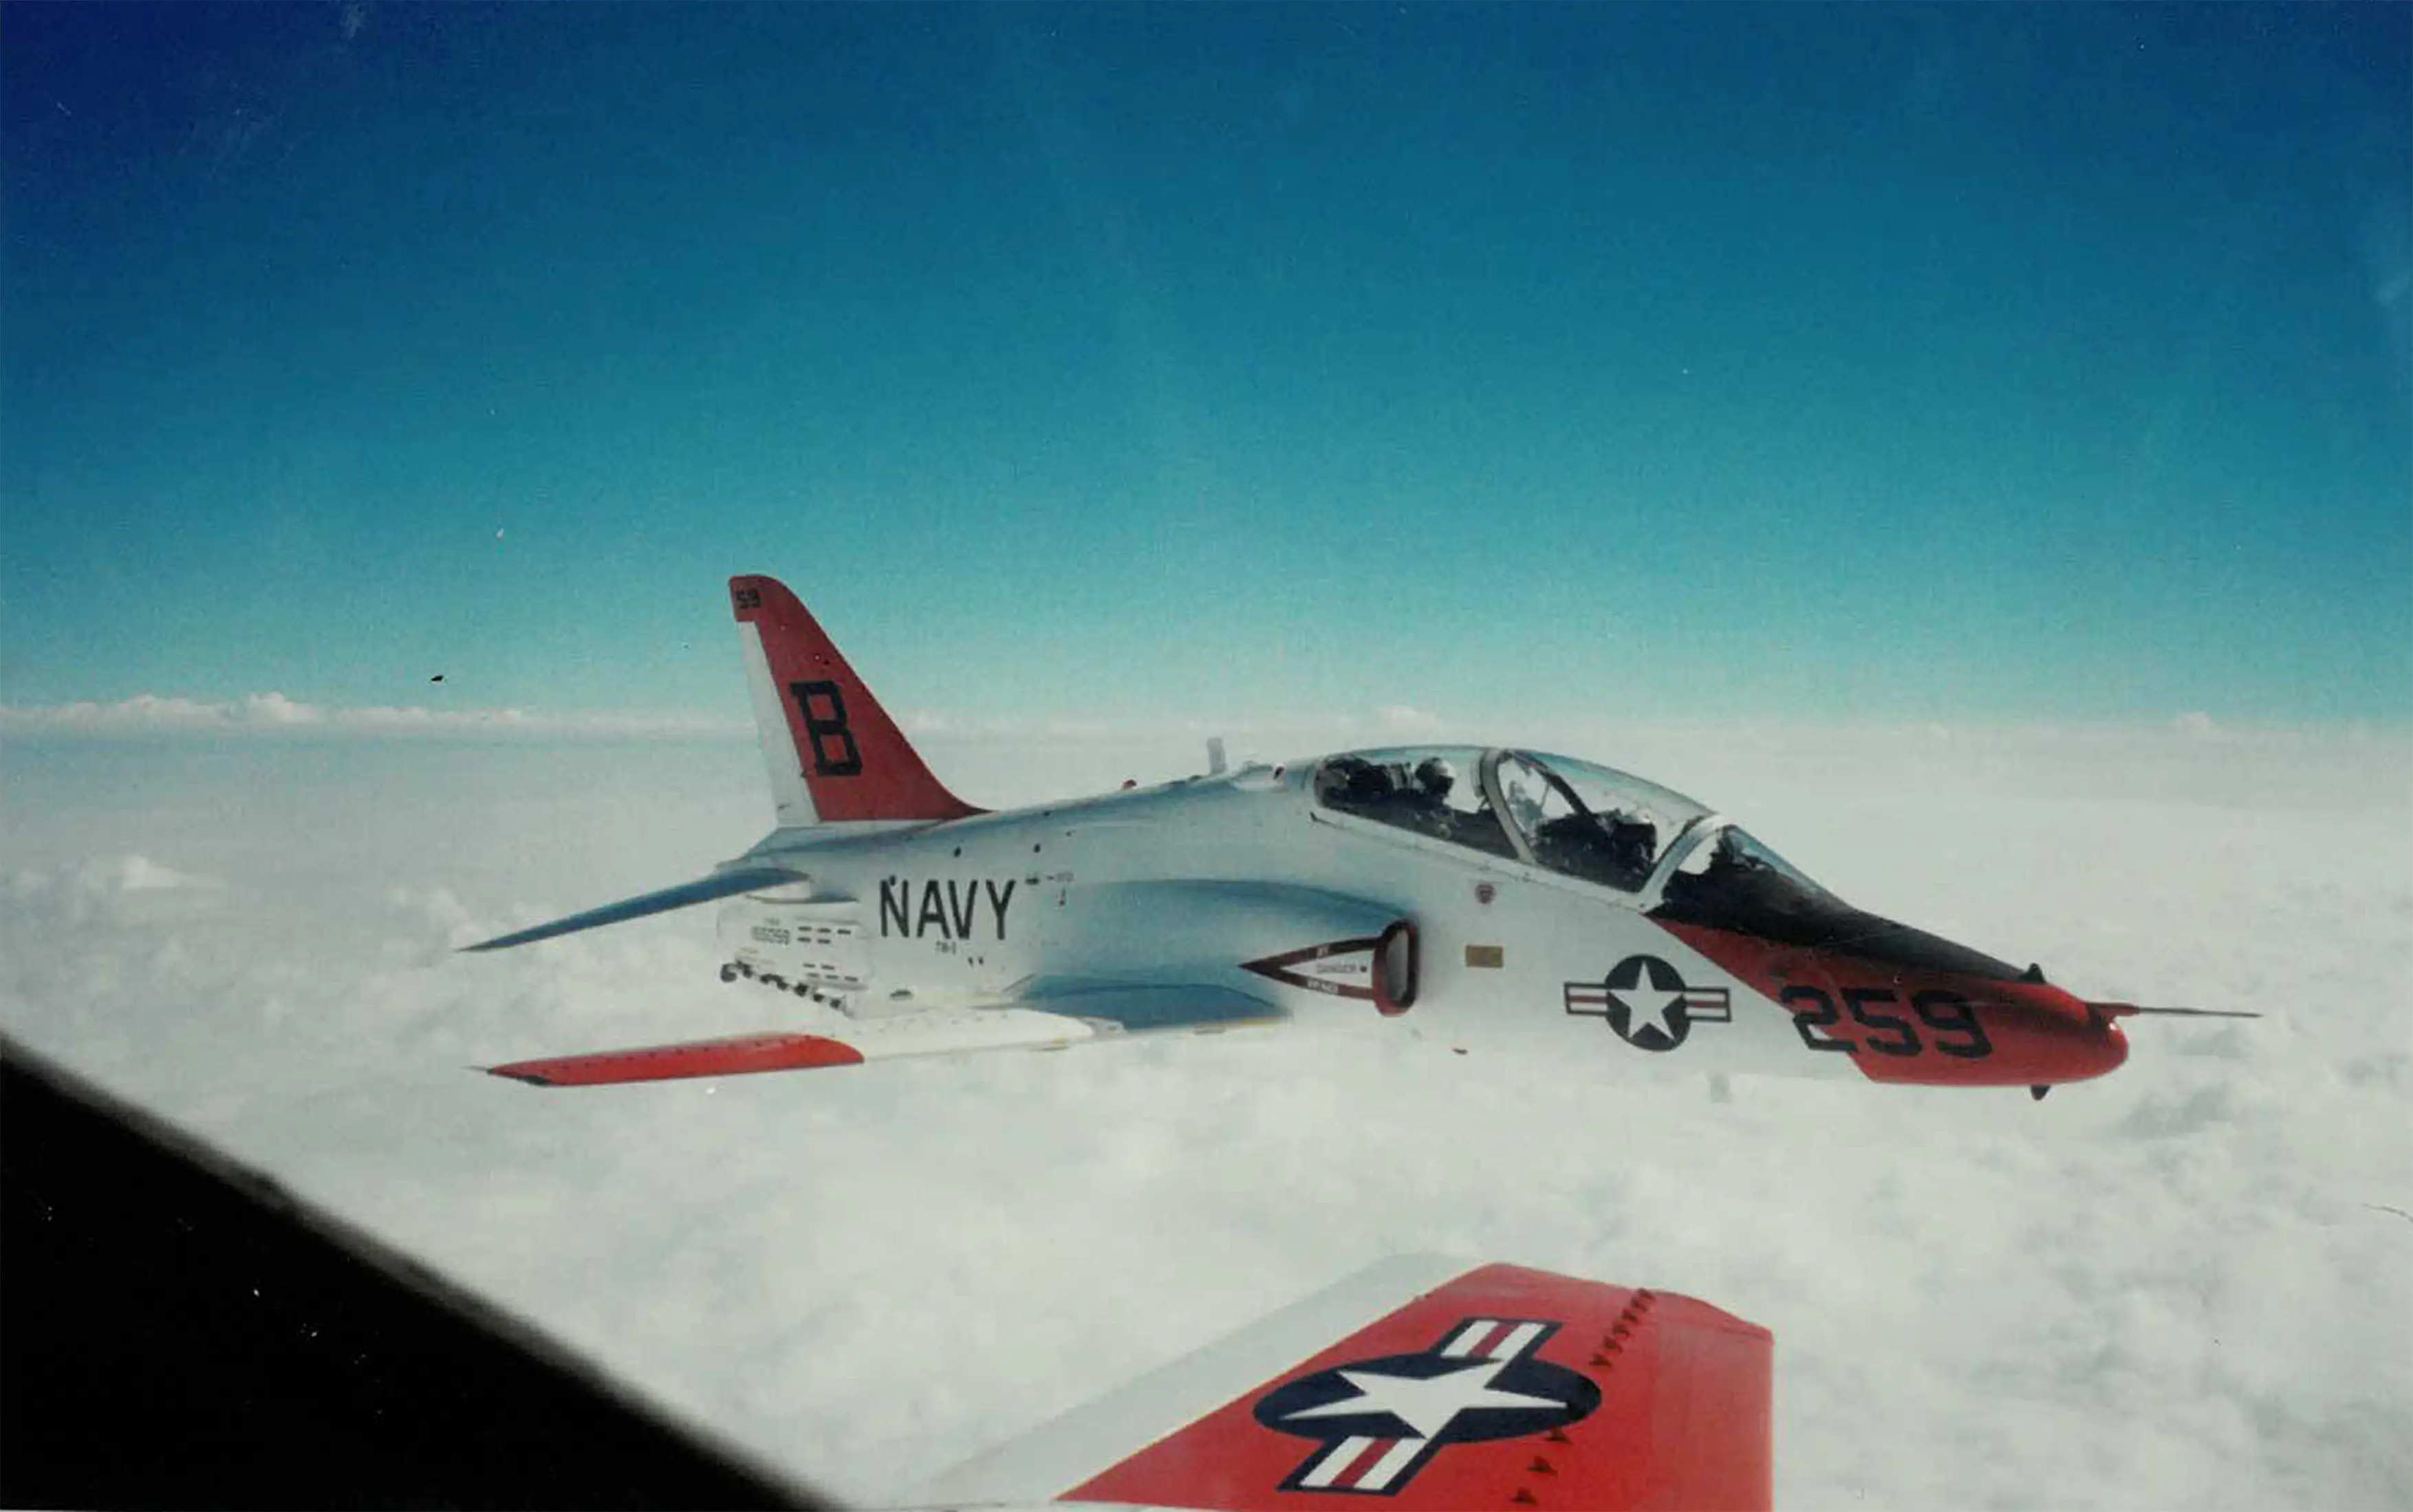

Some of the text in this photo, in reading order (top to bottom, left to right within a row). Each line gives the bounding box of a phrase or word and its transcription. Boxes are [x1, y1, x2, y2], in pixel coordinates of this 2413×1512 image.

[790, 680, 863, 777] B
[880, 880, 1017, 940] NAVY
[1780, 986, 1993, 1058] 259
